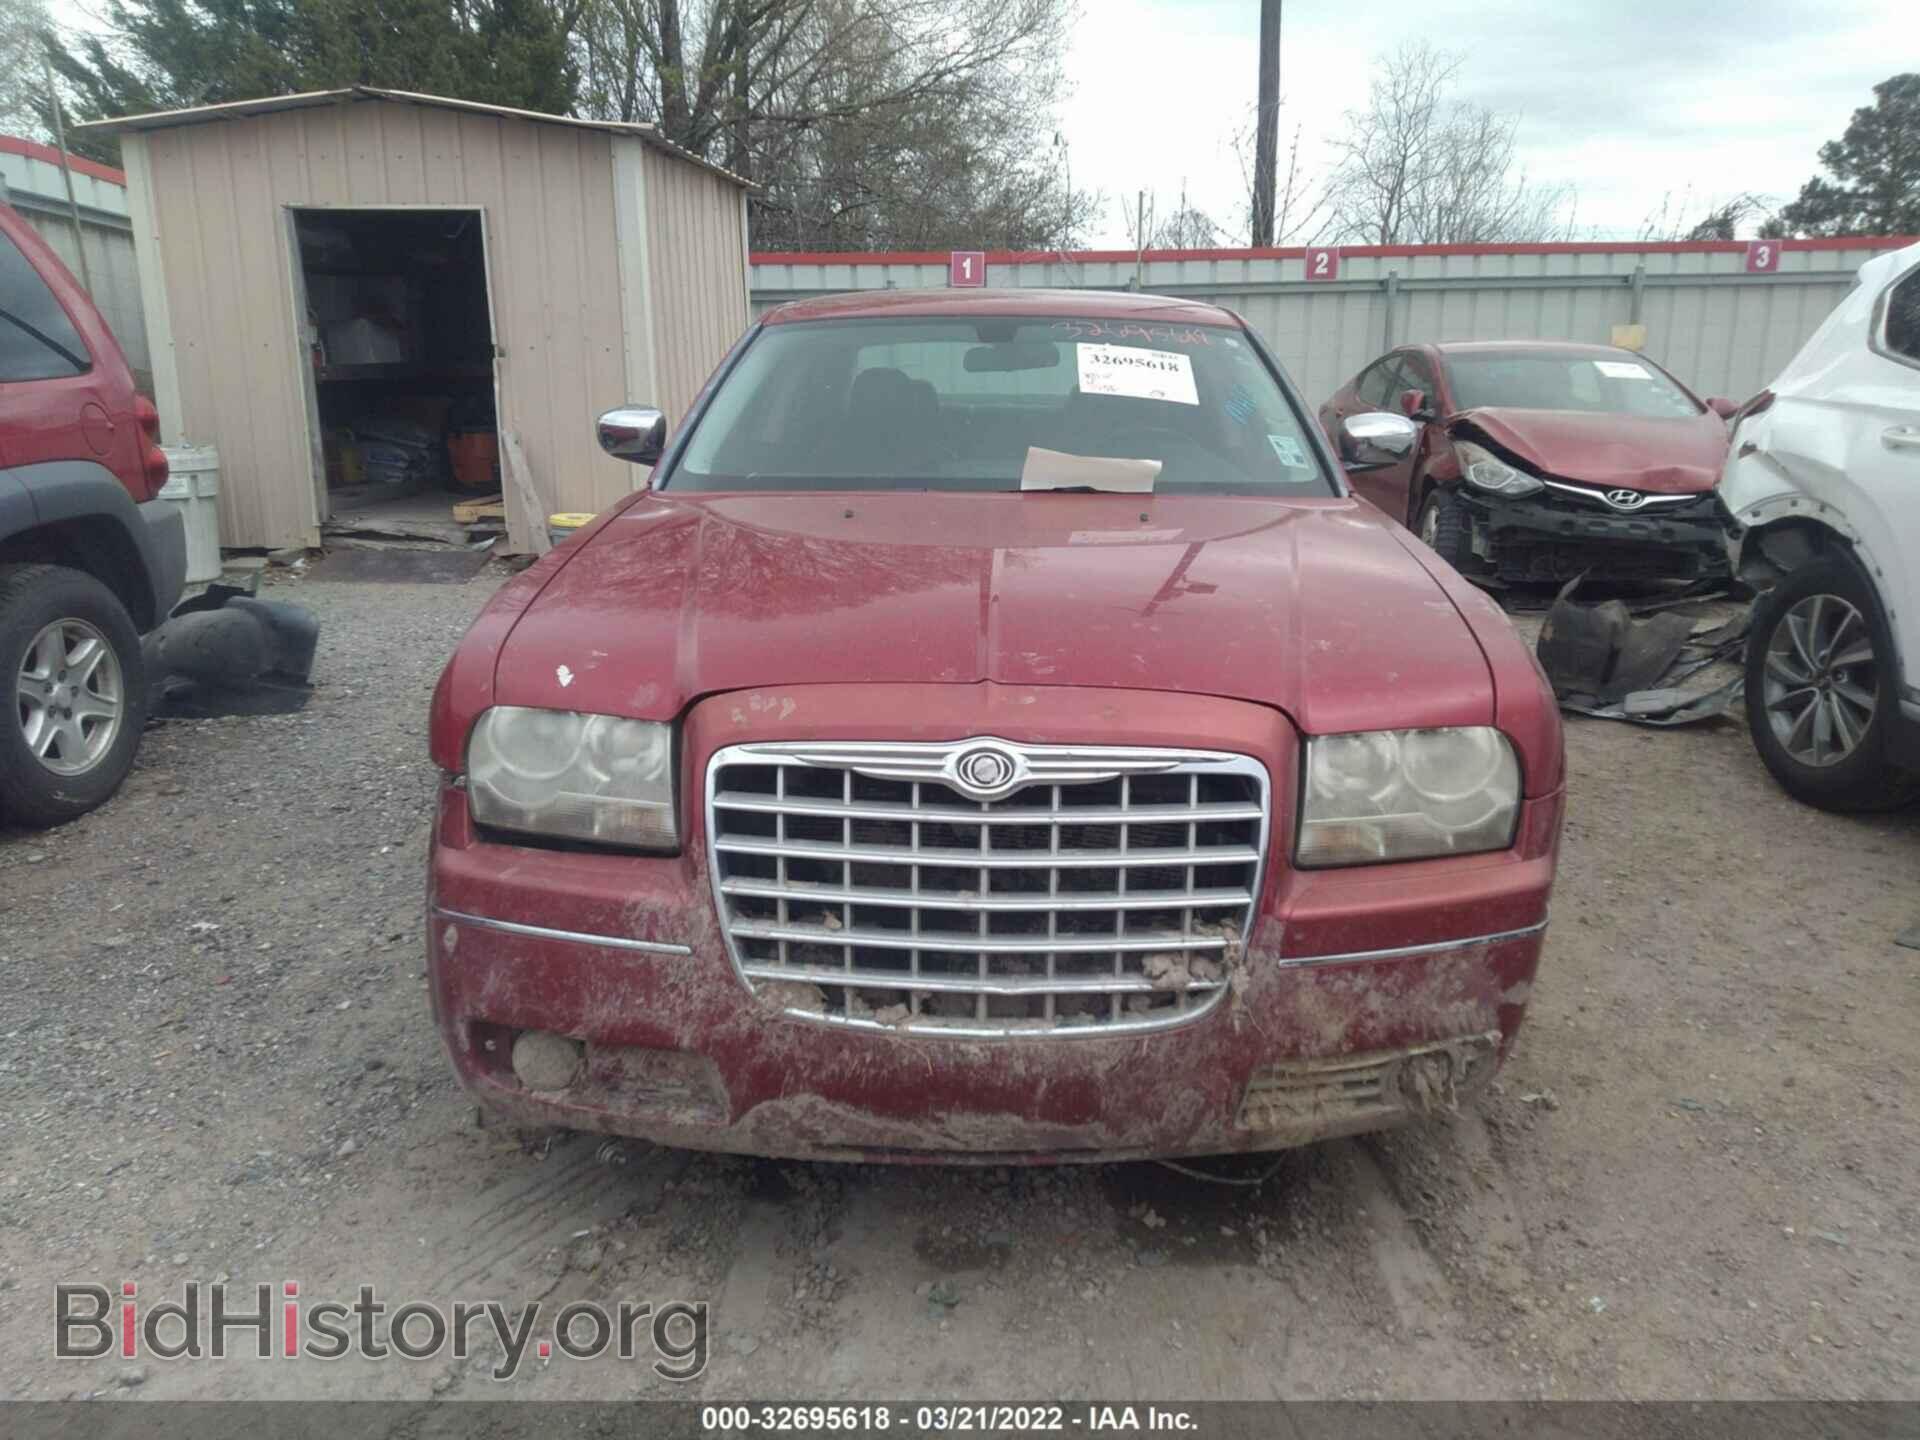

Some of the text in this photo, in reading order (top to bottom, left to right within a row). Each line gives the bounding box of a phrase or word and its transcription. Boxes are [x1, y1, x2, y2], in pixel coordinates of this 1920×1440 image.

[962, 255, 971, 279] 1
[1314, 252, 1329, 275] 2
[1755, 245, 1770, 268] 3
[1089, 354, 1180, 374] 32695618
